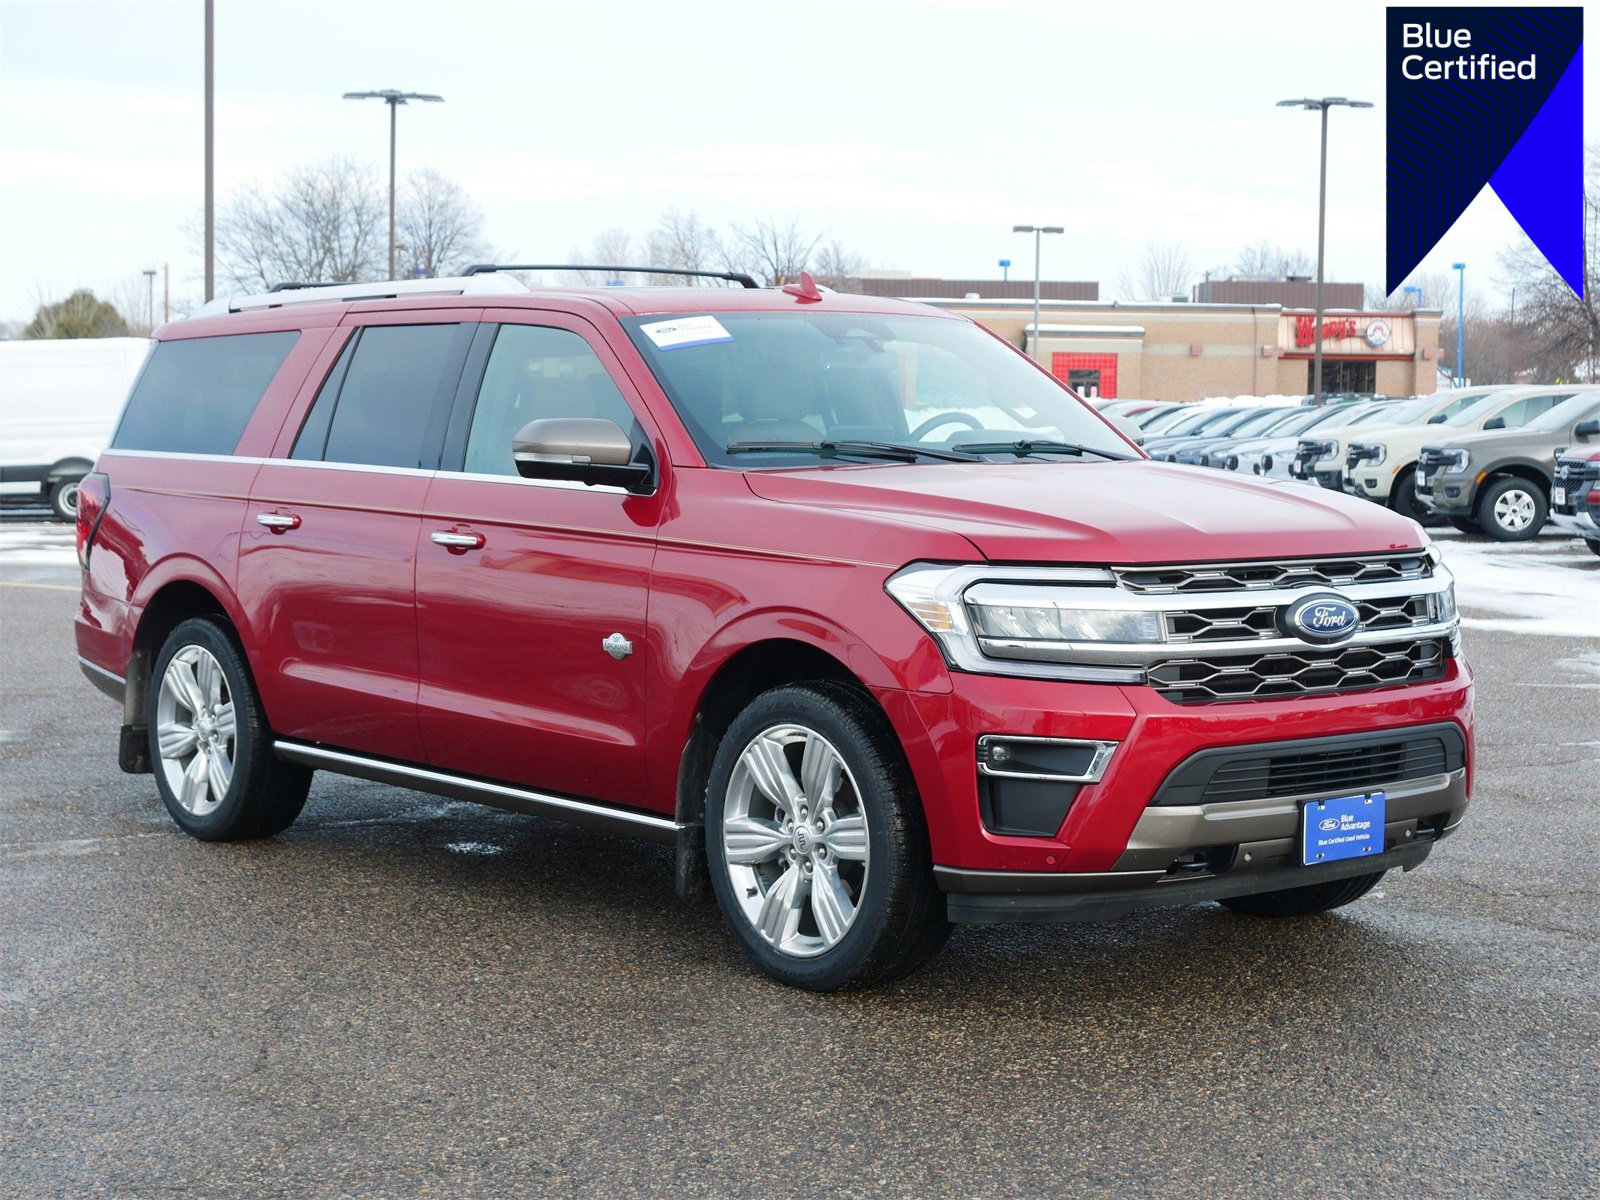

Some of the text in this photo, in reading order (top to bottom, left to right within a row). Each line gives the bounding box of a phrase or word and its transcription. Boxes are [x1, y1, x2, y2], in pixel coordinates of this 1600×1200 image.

[1312, 606, 1347, 628] Ford
[1340, 814, 1354, 823] Blue
[1340, 821, 1371, 831] Advantage
[1328, 837, 1345, 845] Certified
[1355, 833, 1370, 841] Vehicle
